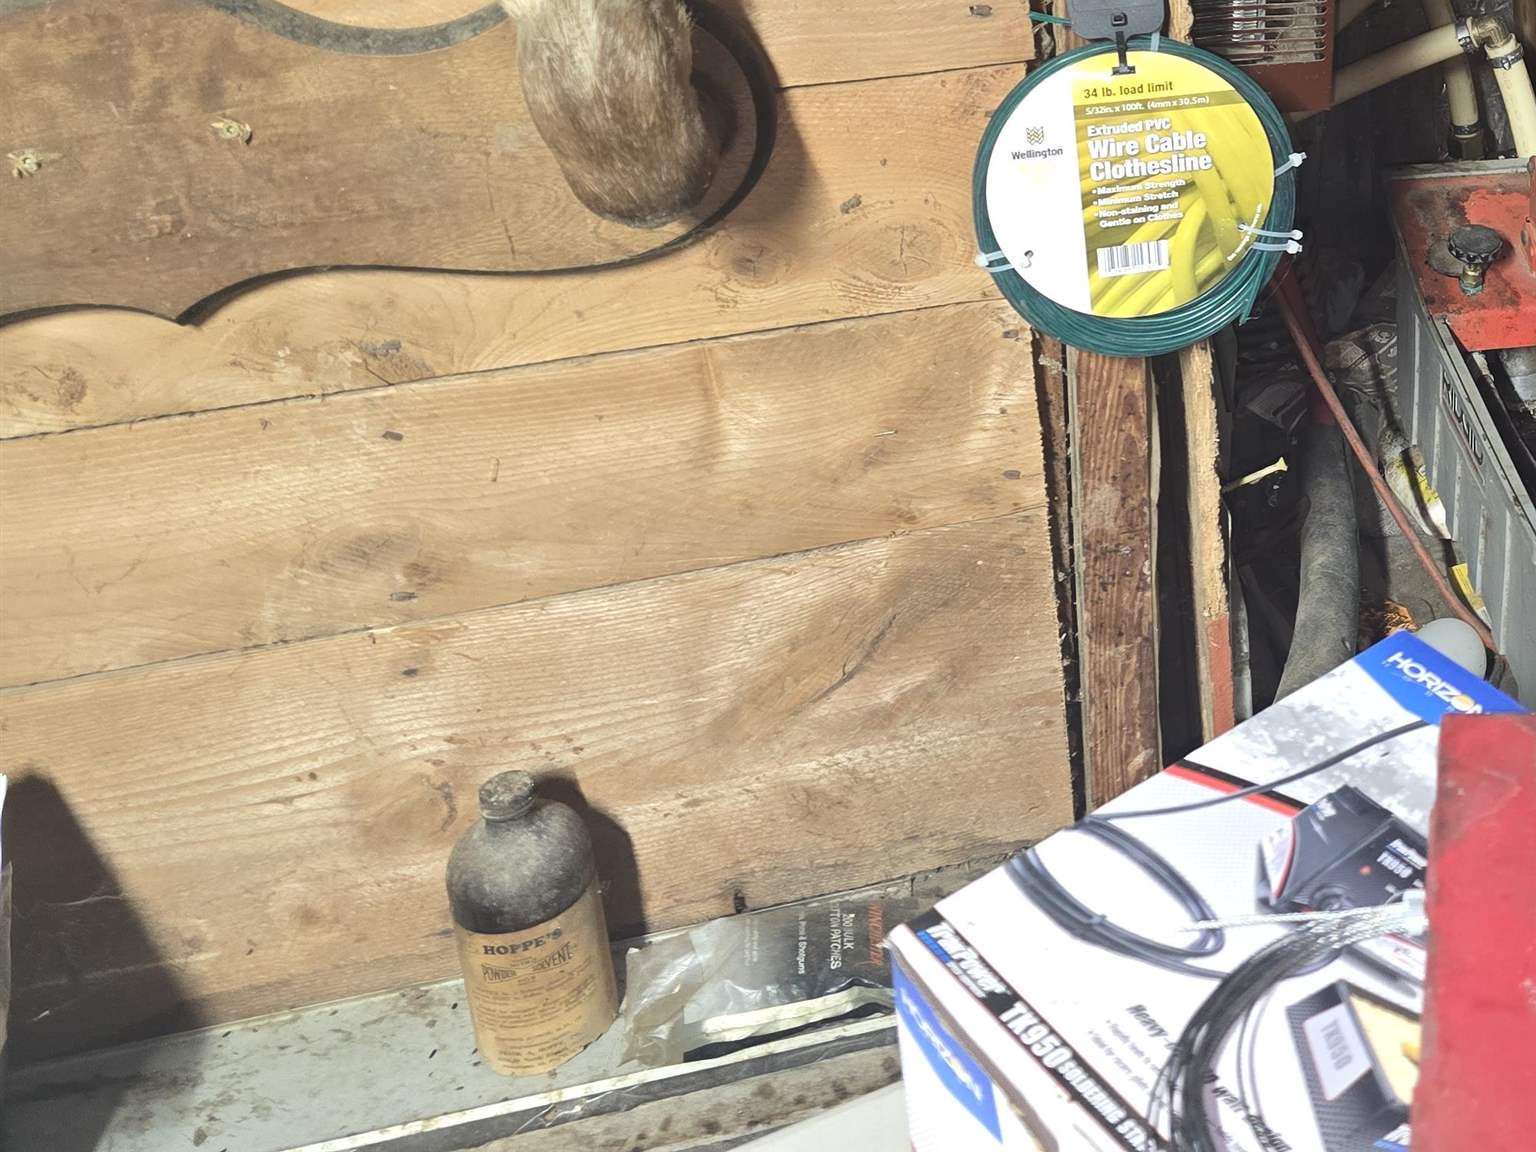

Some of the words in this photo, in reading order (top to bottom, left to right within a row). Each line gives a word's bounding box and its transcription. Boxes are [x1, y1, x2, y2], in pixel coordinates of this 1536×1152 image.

[1084, 88, 1098, 99] 34
[1102, 87, 1116, 97] lb.
[1120, 84, 1143, 96] load
[1148, 81, 1174, 93] limit
[1122, 102, 1145, 112] 100ft.
[1147, 100, 1171, 110] (4mm
[1179, 95, 1210, 105] 30.5m)
[1087, 121, 1143, 137] Extruded
[1145, 118, 1171, 130] PVC
[1011, 147, 1064, 160] Wellington
[1087, 138, 1140, 160] Wire
[1144, 130, 1207, 154] Cable
[1089, 152, 1213, 182] Clothesline
[1143, 191, 1179, 201] Stretch
[1160, 201, 1179, 210] and
[1100, 217, 1132, 228] Gentle
[1133, 216, 1146, 224] on
[483, 928, 562, 955] HOPPE'S
[830, 930, 842, 970] PATCHES
[998, 1000, 1075, 1069] TK950
[1058, 1058, 1127, 1125] SOLDERING
